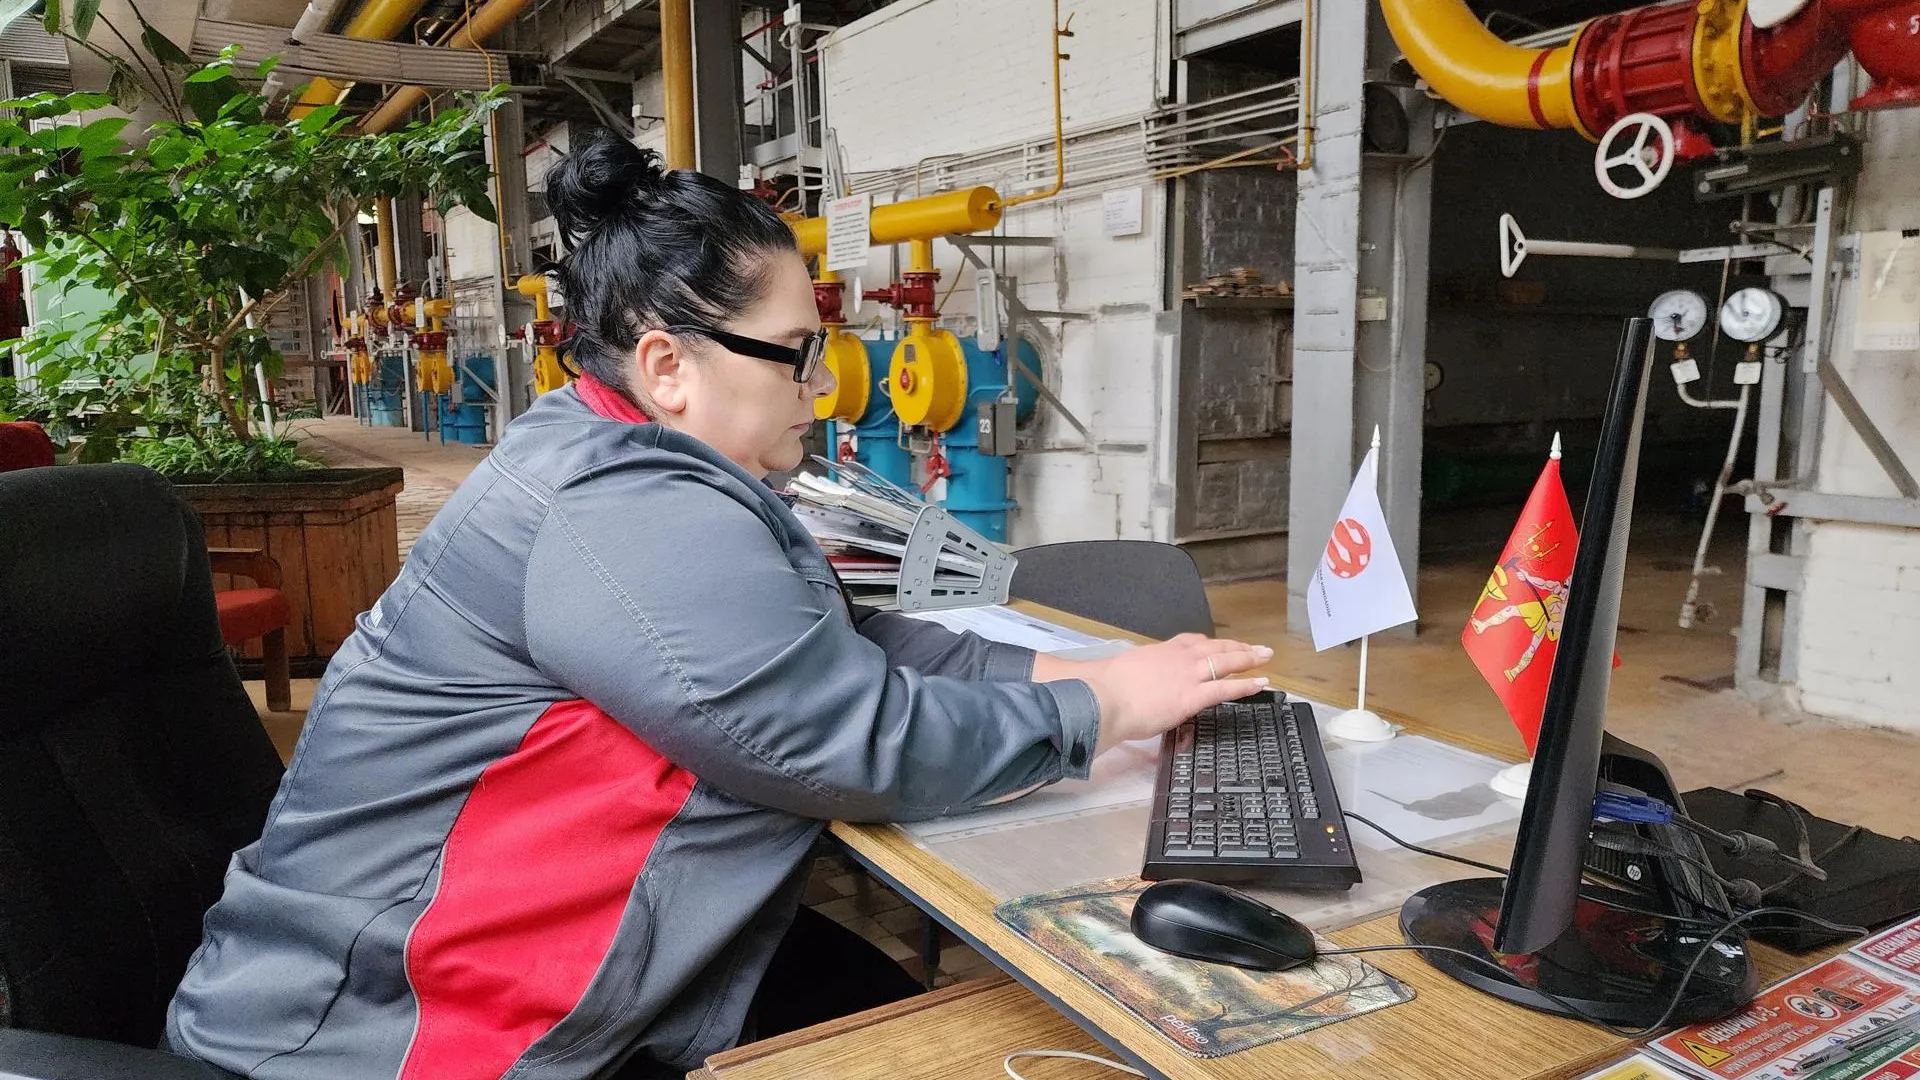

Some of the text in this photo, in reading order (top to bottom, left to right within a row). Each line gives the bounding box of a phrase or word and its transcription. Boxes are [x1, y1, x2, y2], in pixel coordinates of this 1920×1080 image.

[979, 418, 991, 434] 23
[1627, 865, 1641, 880] hp
[1159, 1014, 1209, 1044] perfeo
